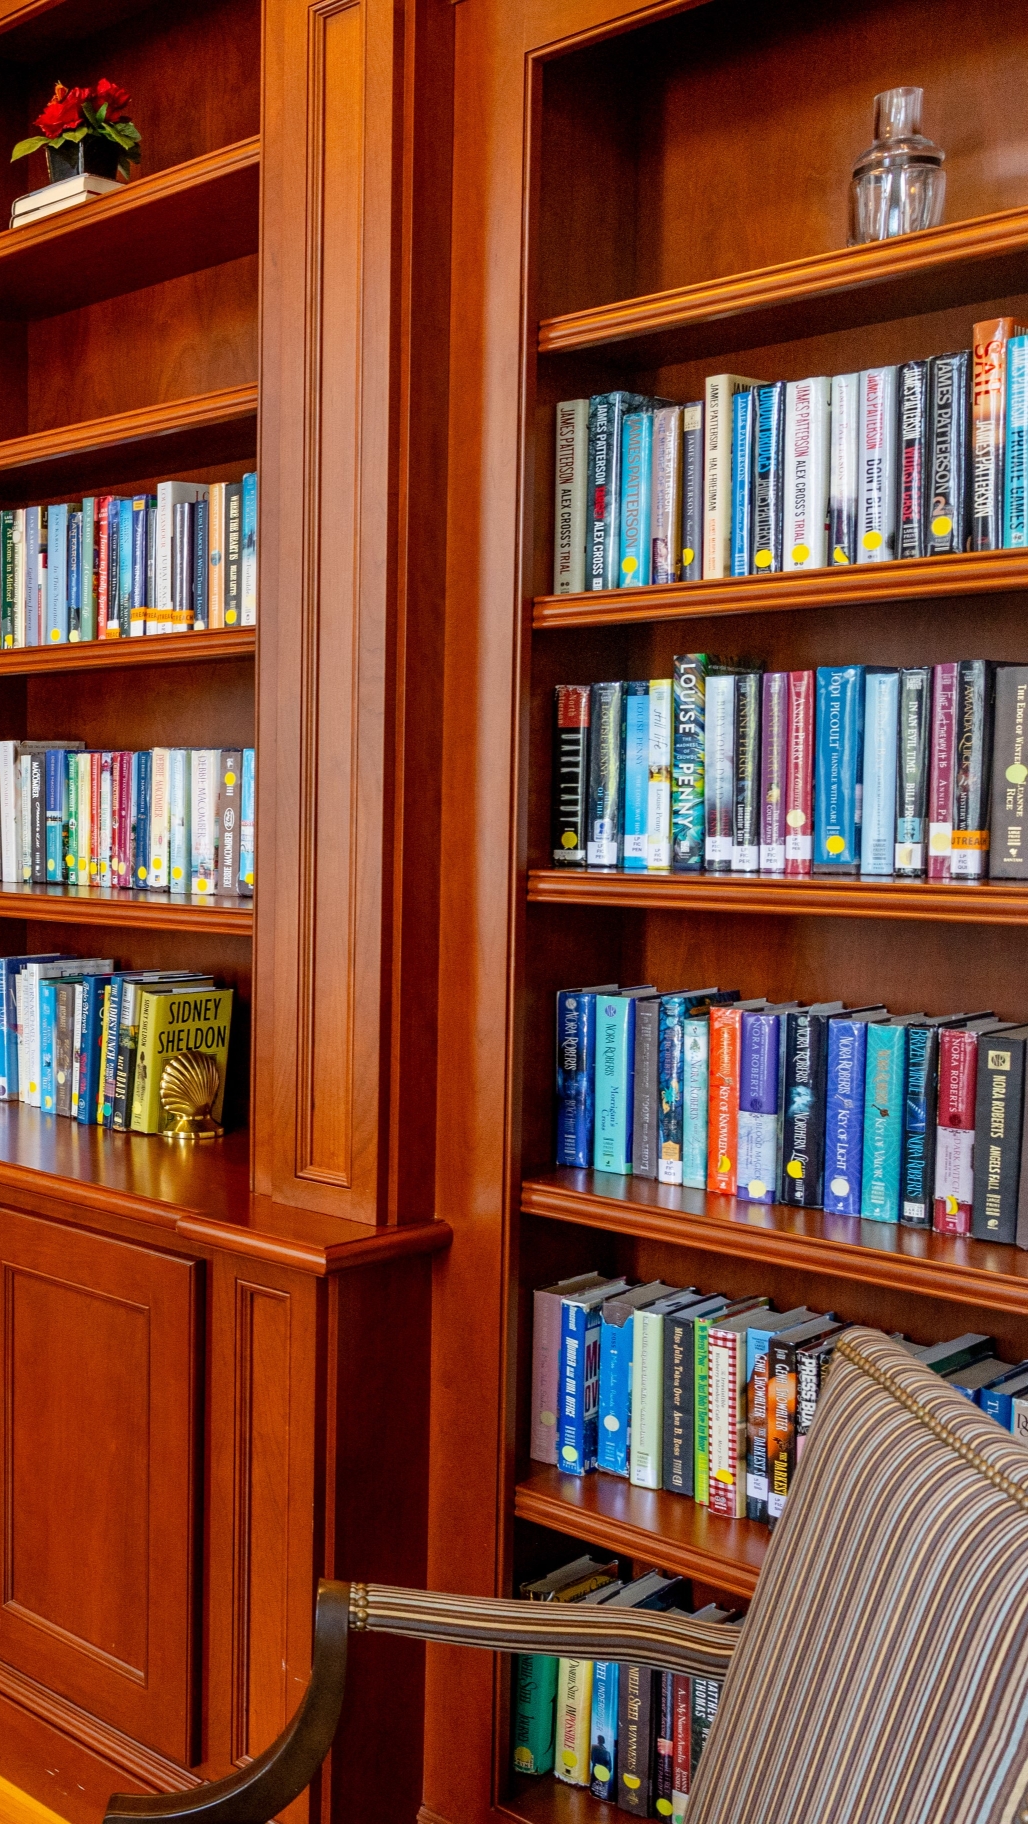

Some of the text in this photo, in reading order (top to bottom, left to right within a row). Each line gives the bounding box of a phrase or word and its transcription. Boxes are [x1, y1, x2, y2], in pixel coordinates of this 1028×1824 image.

[974, 341, 1004, 405] SAIL
[710, 384, 718, 408] JAMES
[597, 404, 606, 432] JAMES
[709, 410, 718, 450] PATTERSON
[759, 389, 777, 472] LONDON BRIDGES
[935, 359, 952, 493] JAMES PATTERSON
[596, 434, 606, 484] PATTERSON
[687, 435, 695, 462] JAMES
[902, 368, 920, 521] JAMES PATTERSON WORST CASE
[626, 419, 642, 548] JAMES PATTERSON
[975, 420, 995, 517] JAMES PATTERSON
[1010, 431, 1025, 530] PRIVATE GAMES
[229, 495, 238, 517] WHERE
[559, 408, 575, 574] JAMES PATTERSON ALEX CROSS'S TRIAL
[709, 473, 717, 511] FRIEDMAN
[7, 529, 13, 538] At
[229, 533, 239, 553] HEART
[230, 519, 238, 531] THE
[594, 522, 604, 543] ALEX
[593, 545, 603, 574] CROSS
[831, 672, 842, 697] JODI
[636, 702, 644, 733] LOUISE
[830, 702, 839, 749] PICOULT
[959, 685, 973, 768] AMANDA QUICK
[1017, 685, 1026, 734] THE EDGE OF
[679, 664, 696, 829] LOUISE PENNY
[716, 732, 724, 763] YOUR
[794, 697, 804, 764] ANNE PERRY
[906, 702, 917, 802] IN AN EVIL TIME BILL
[198, 756, 206, 837] DEBBIE MACOMBER
[560, 734, 581, 822] DARK LADY
[716, 768, 724, 799] DEAD
[1006, 788, 1015, 809] RICE
[655, 812, 663, 832] Penny
[141, 999, 150, 1046] SIDNEY SHELDON
[168, 997, 222, 1025] SIDNEY
[107, 1031, 117, 1059] LUNCH
[157, 1025, 227, 1054] SHELDON
[603, 1024, 616, 1077] NORA ROBERTS
[750, 1022, 760, 1097] NORA ROBERTS
[836, 1036, 853, 1094] NORA ROBERTS
[909, 1029, 928, 1093] BRAZEN VIRTUE
[116, 1071, 126, 1099] ROADS
[689, 1059, 701, 1120] NORA ROBERTS
[601, 1109, 609, 1131] Cross
[610, 1086, 619, 1127] Morrigan's
[836, 1110, 849, 1169] KEY OF LIGHT
[988, 1075, 1006, 1189] NORA ROBERTS ANGELS FALL
[754, 1151, 762, 1180] MAGICK
[907, 1134, 925, 1196] NORA ROBERTS
[952, 1138, 962, 1193] DARK WITCH
[674, 1327, 683, 1343] Miss
[674, 1345, 683, 1363] Julia
[674, 1367, 682, 1385] Takes
[755, 1354, 765, 1373] GENA
[775, 1364, 788, 1383] GENA
[802, 1358, 815, 1398] PRESS
[673, 1388, 682, 1405] Over
[754, 1377, 765, 1417] SHOWALTER
[775, 1388, 788, 1431] SHOWALTER
[673, 1411, 682, 1424] Ann
[673, 1438, 681, 1455] Ross
[754, 1437, 766, 1468] DARKEST
[774, 1461, 787, 1495] DARKEST
[596, 1682, 604, 1732] UNDERCOVER
[695, 1680, 706, 1717] THOMAS
[564, 1705, 575, 1751] IMPOSSIBLE
[628, 1696, 641, 1770] STEEL WINNERS
[677, 1740, 685, 1762] Amelia
